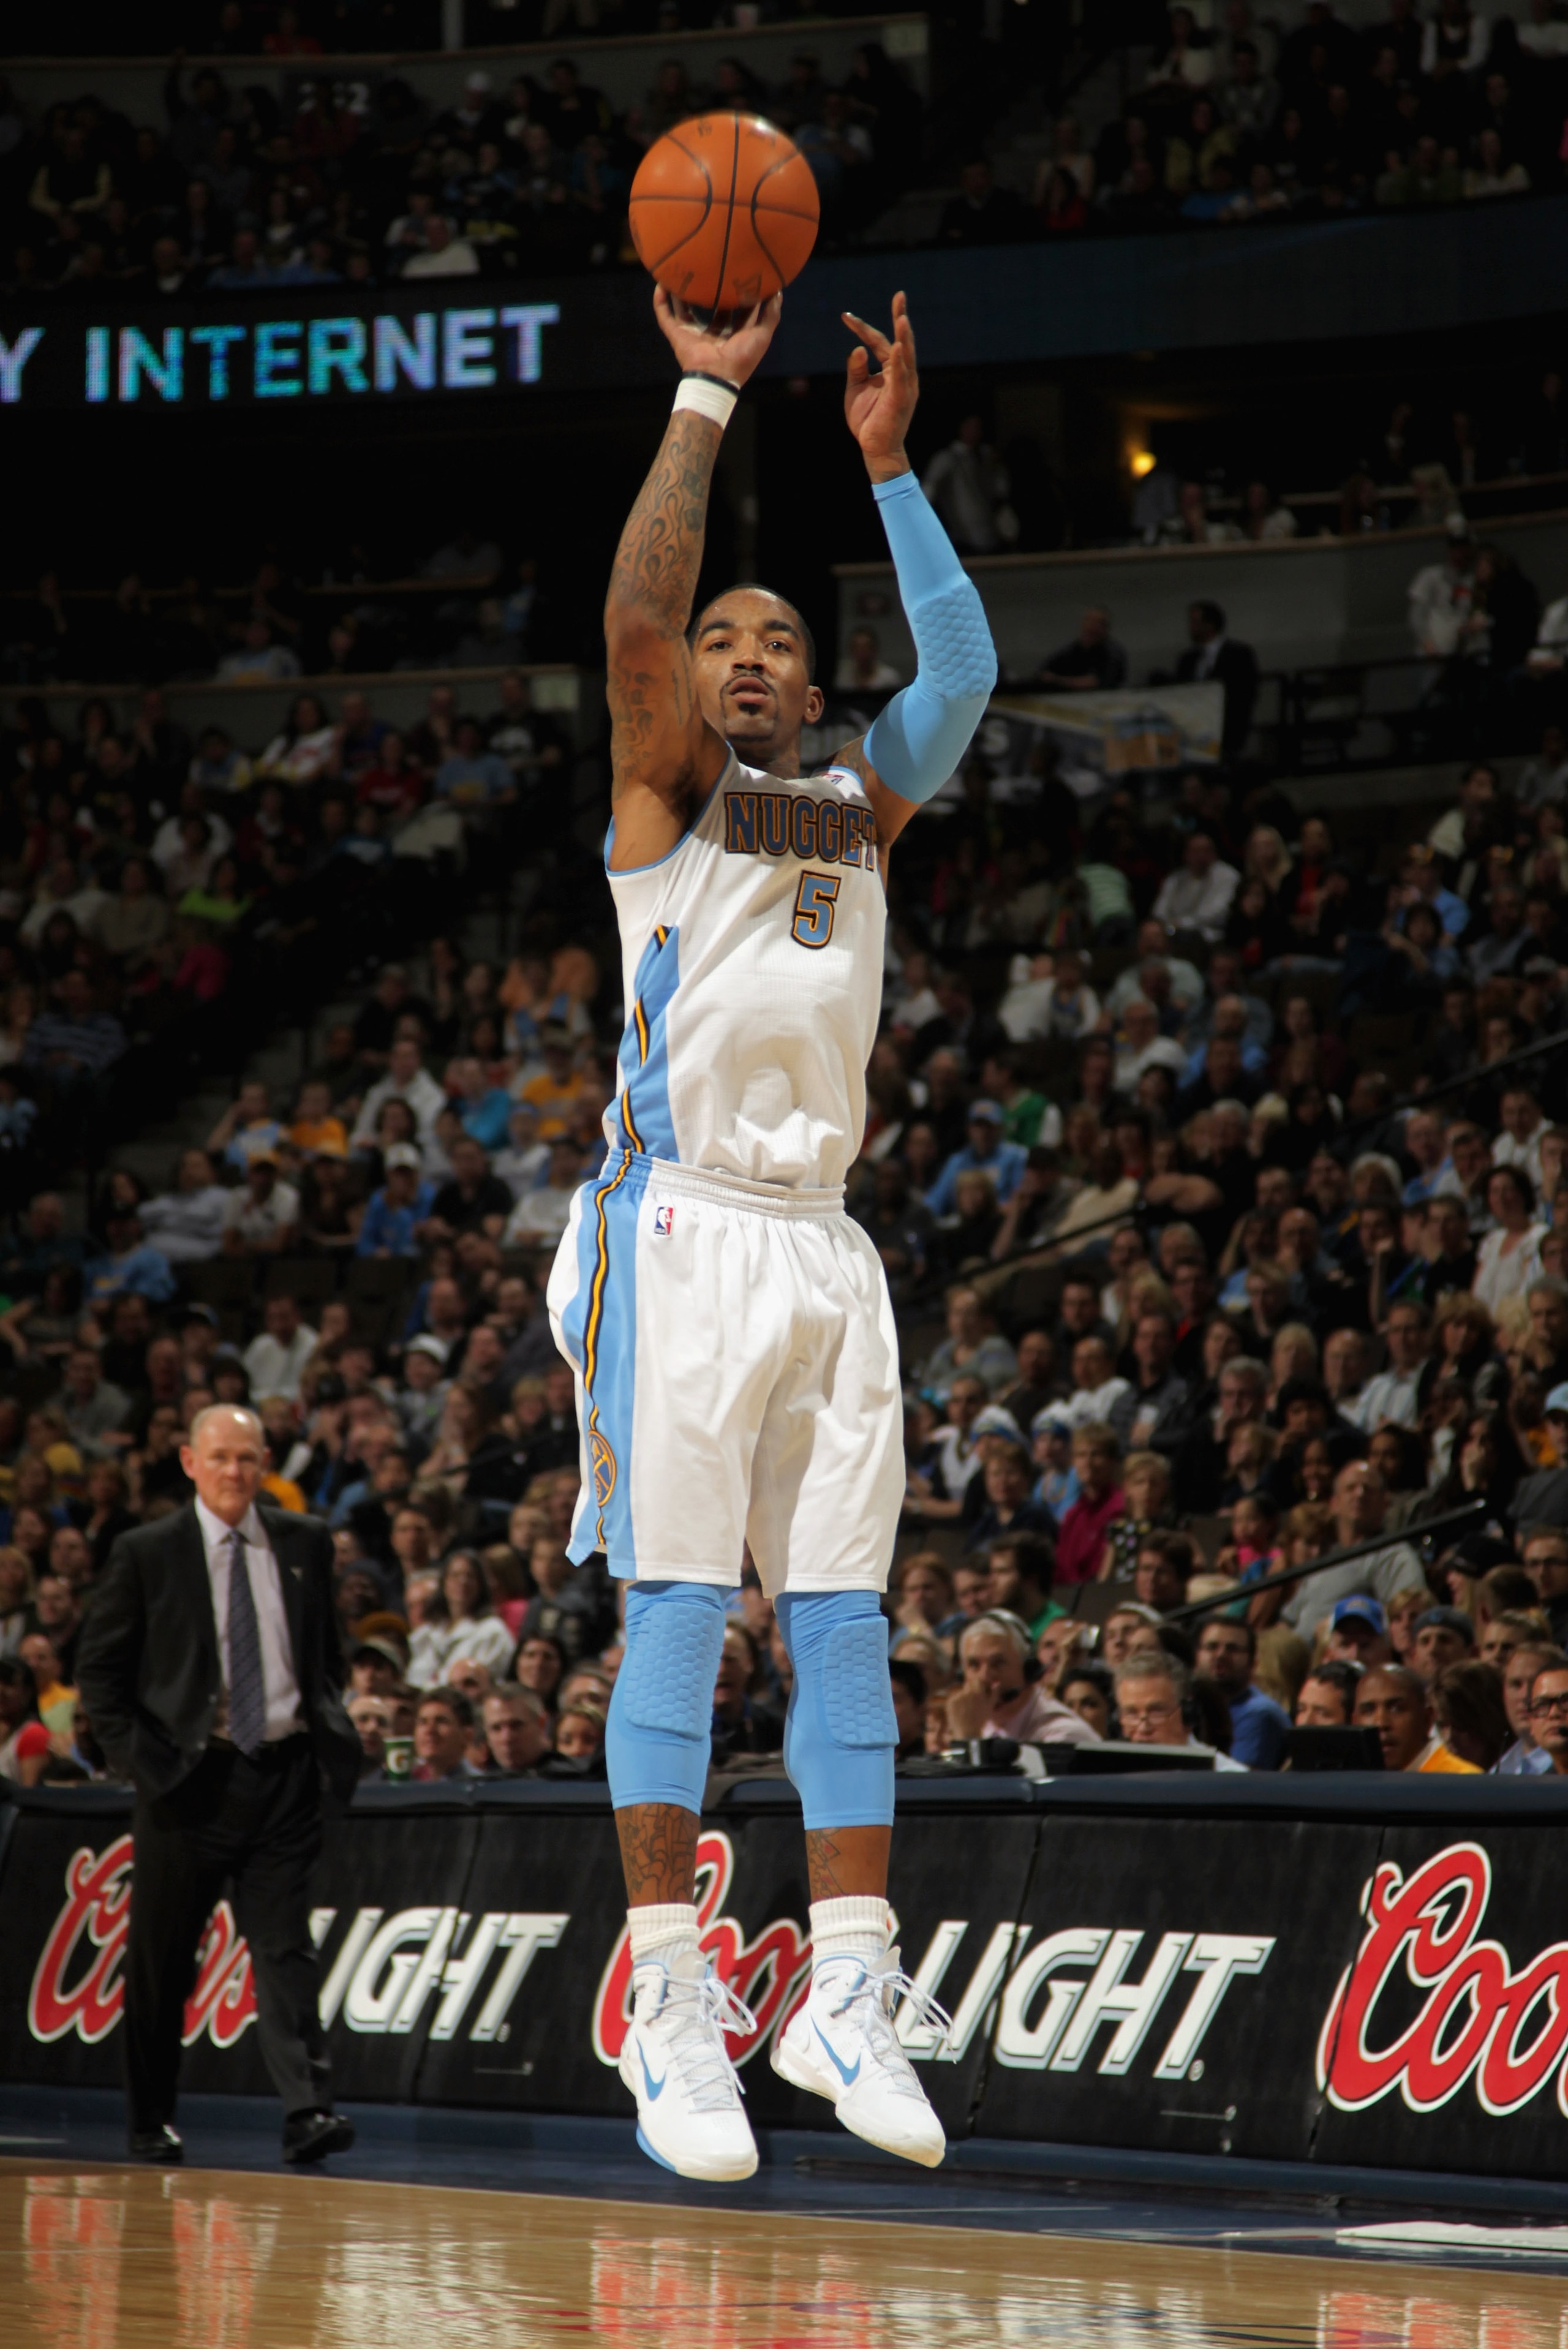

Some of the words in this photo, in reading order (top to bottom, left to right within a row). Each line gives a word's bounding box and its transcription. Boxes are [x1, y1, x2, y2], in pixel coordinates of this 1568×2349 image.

[0, 327, 45, 402] Y
[85, 304, 560, 402] INTERNET
[791, 869, 842, 949] 5
[386, 1747, 410, 1774] G
[892, 1920, 1276, 2080] LIGHT
[1316, 1841, 1568, 2117] Coo
